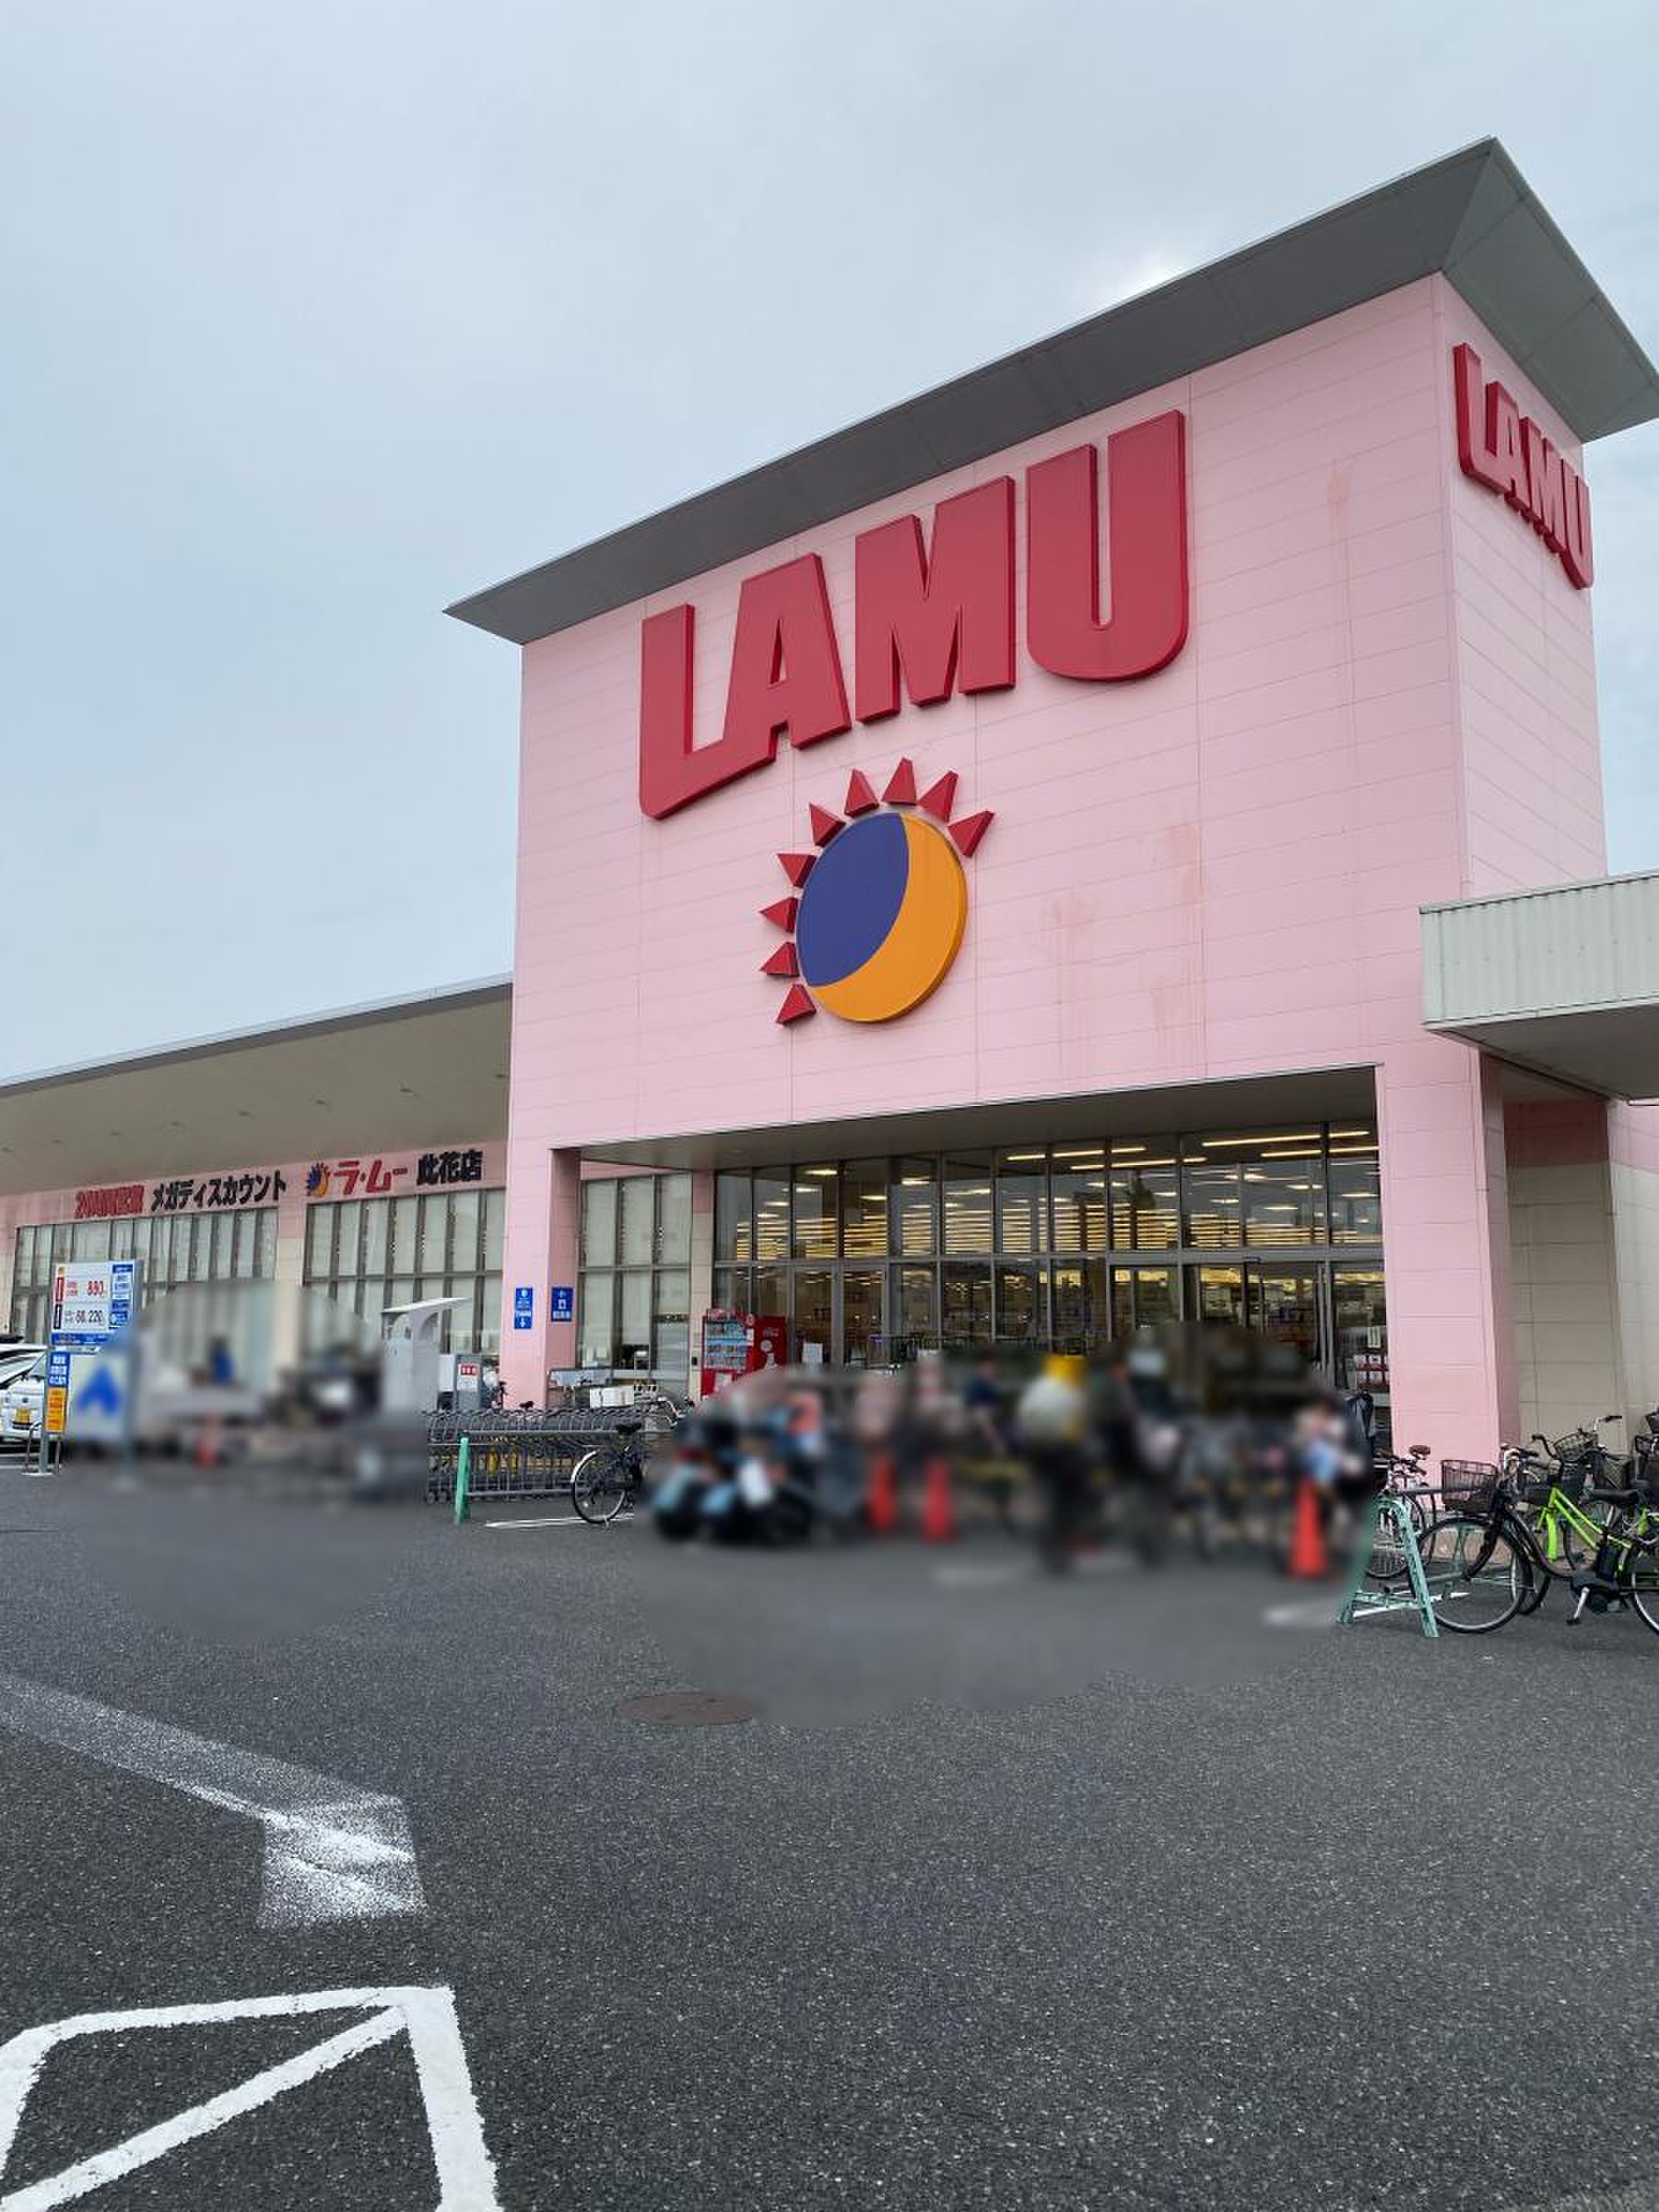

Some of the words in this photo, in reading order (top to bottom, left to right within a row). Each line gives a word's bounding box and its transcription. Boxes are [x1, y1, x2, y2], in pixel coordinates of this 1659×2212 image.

[1453, 342, 1594, 590] LAMU
[639, 409, 1190, 820] LAMU
[150, 1170, 287, 1212] メガディスカウント
[417, 1147, 484, 1186] 此花店
